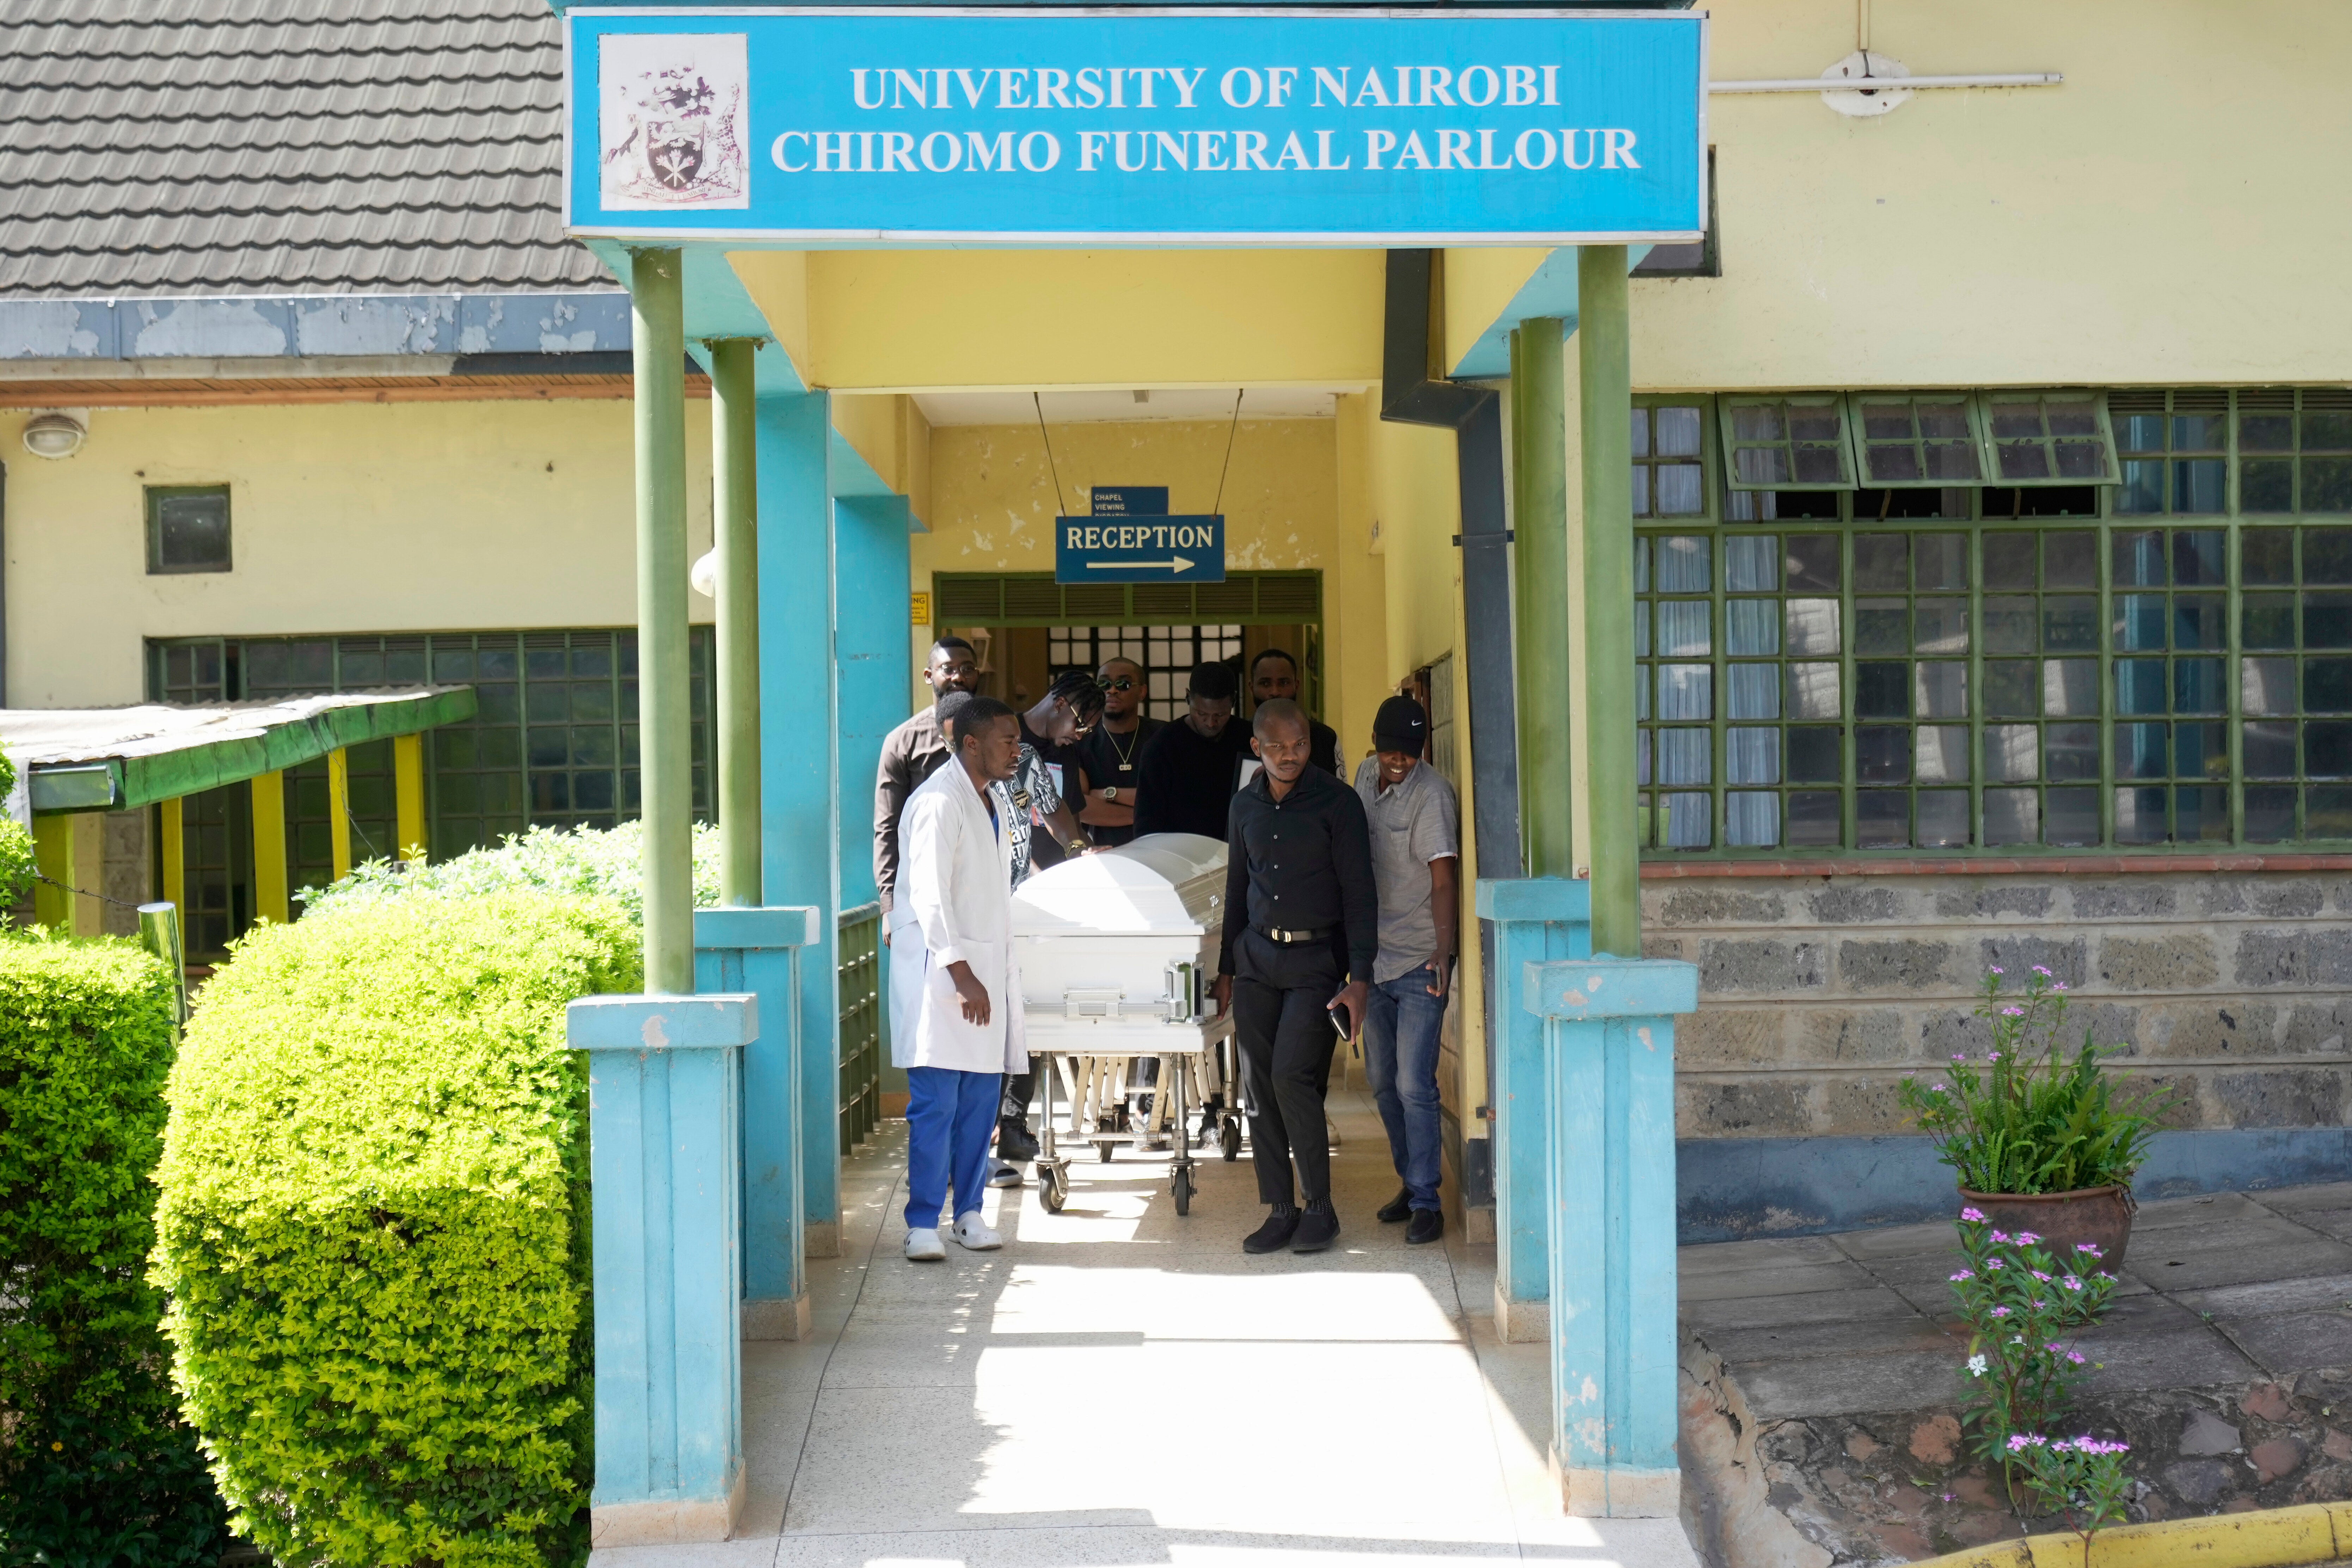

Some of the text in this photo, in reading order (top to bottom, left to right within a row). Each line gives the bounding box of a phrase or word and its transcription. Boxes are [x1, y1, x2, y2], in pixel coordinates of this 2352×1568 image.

[849, 66, 1561, 110] UNIVERSITY OF NAIROBI
[771, 129, 1642, 173] CHIROMO FUNERAL PARLOUR
[1067, 526, 1213, 549] RECEPTION
